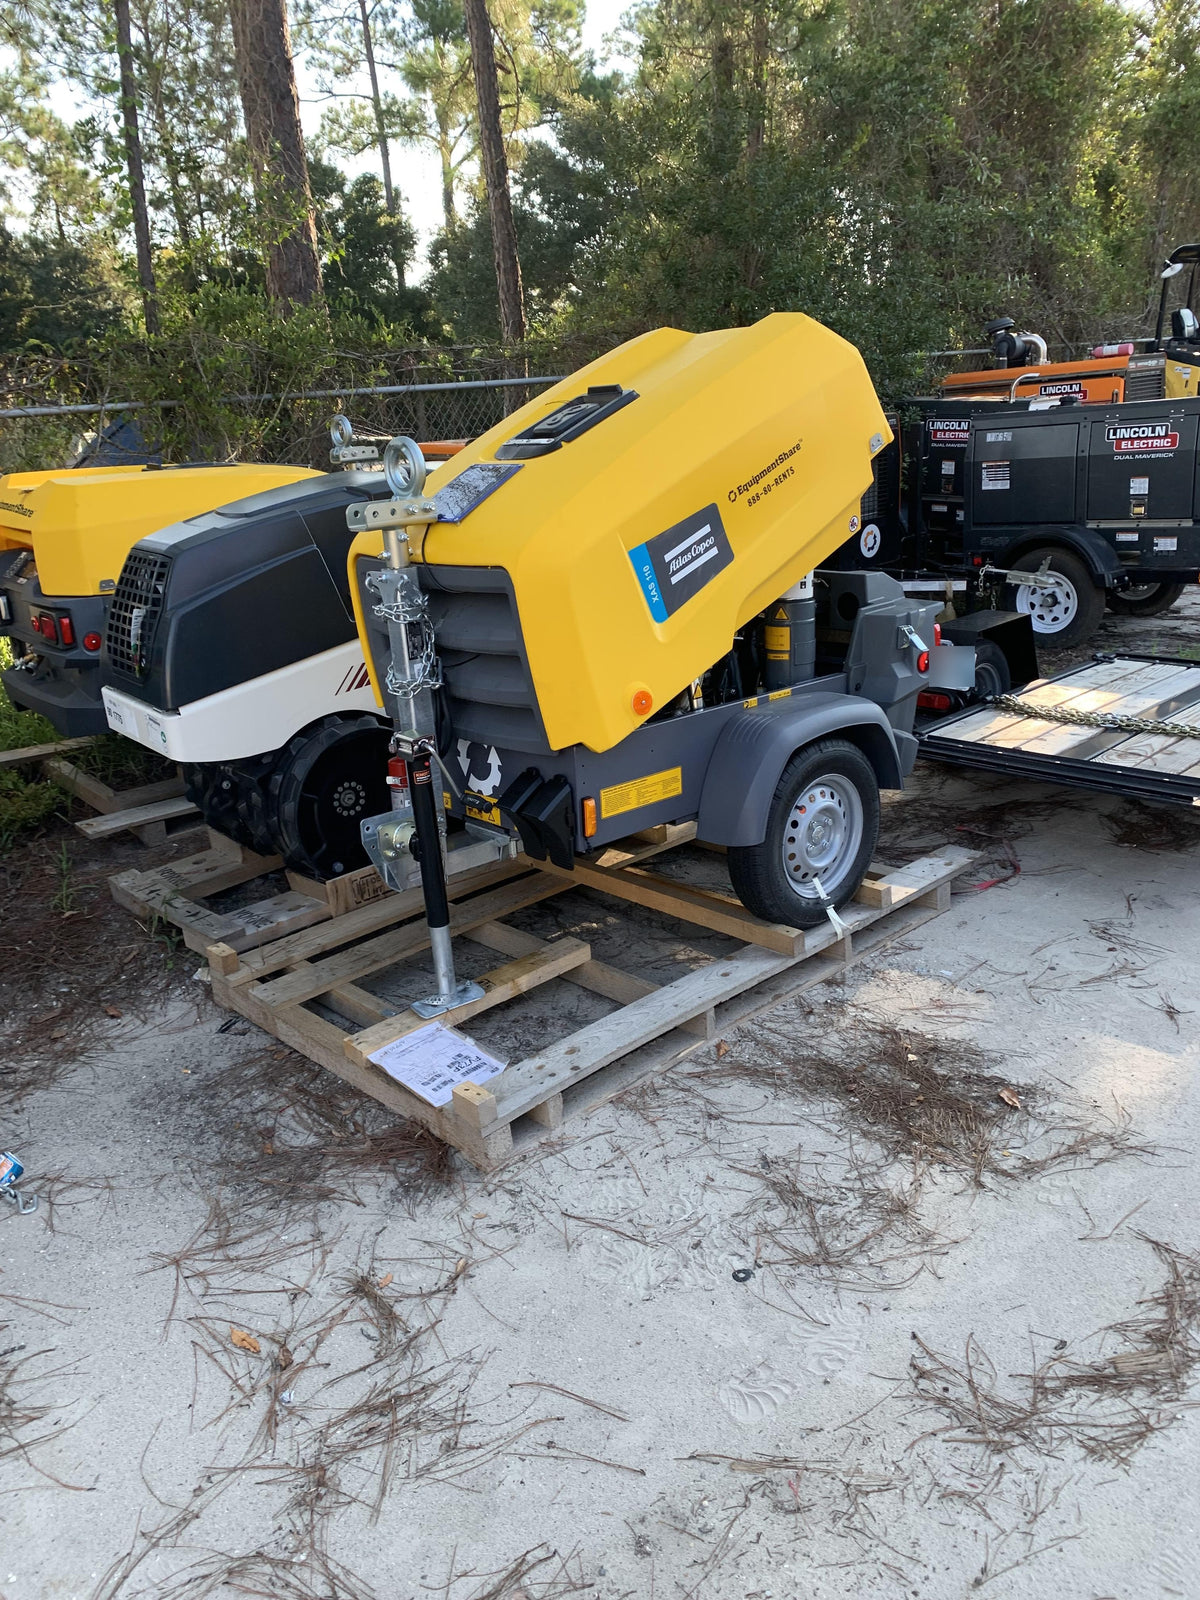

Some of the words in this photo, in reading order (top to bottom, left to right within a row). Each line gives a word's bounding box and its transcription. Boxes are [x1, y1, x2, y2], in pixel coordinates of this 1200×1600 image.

[1041, 384, 1080, 395] LINCOLN
[929, 421, 969, 430] LINCOLN
[1109, 426, 1166, 439] LINCOLN
[1121, 439, 1171, 449] ELECTRIC
[1134, 452, 1175, 460] MAVERICK
[737, 443, 801, 495] EquipmentShare
[747, 466, 795, 507] 888-80-RENTS
[643, 565, 652, 581] 110
[648, 582, 660, 603] XAS
